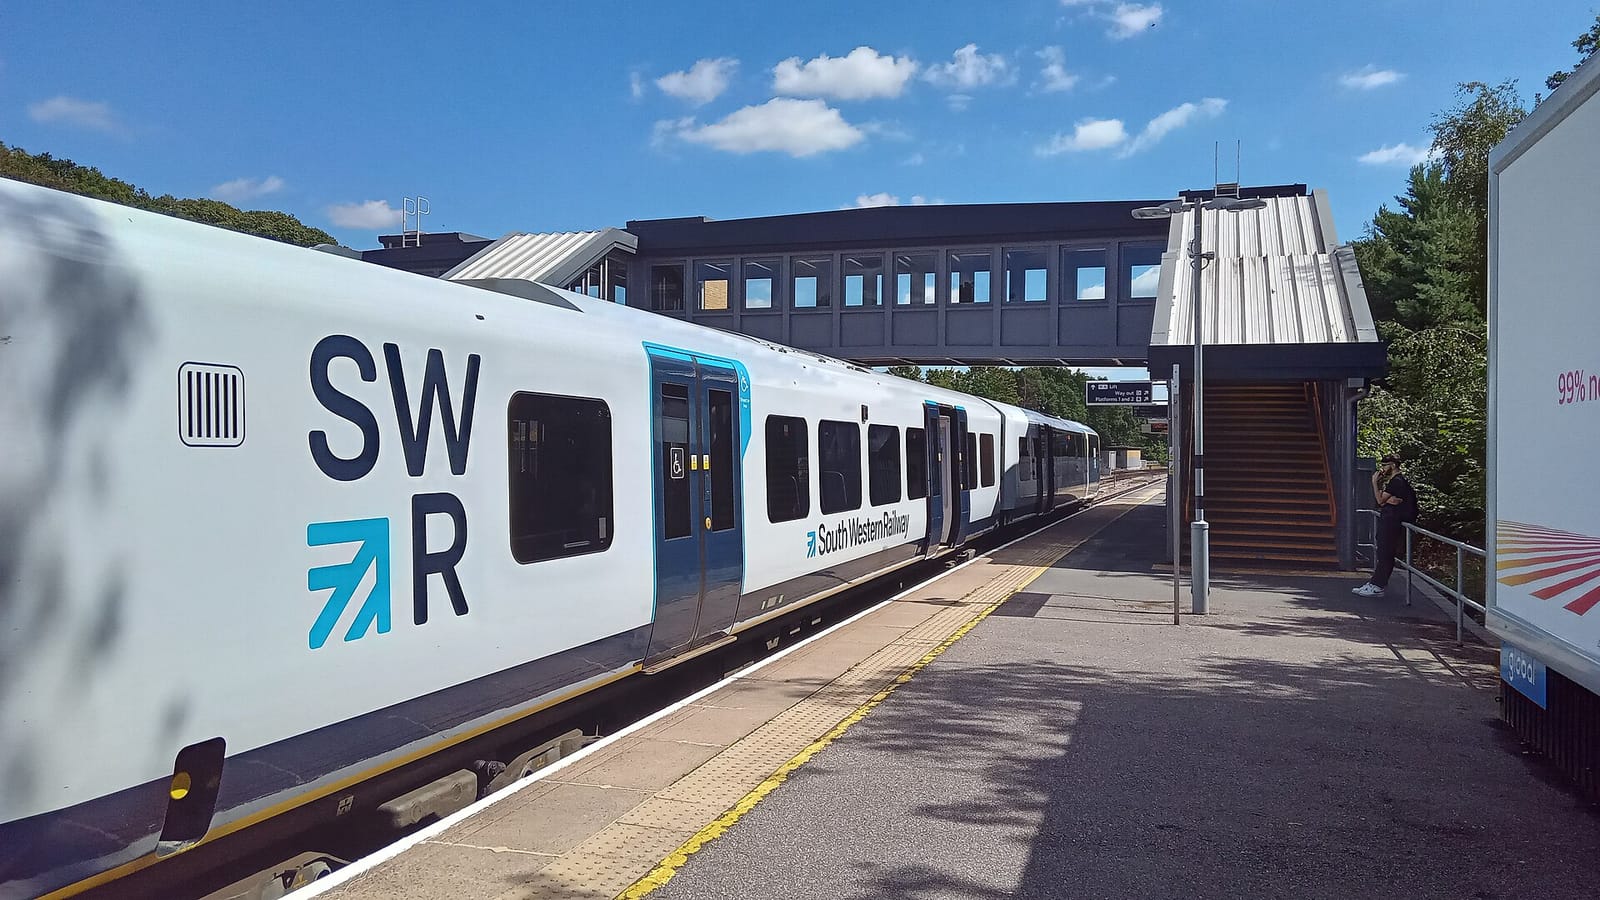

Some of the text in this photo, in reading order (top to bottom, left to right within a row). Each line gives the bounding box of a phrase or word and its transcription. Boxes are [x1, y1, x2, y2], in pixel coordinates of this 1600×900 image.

[308, 334, 481, 481] SW
[1558, 370, 1585, 405] 99%
[411, 492, 469, 625] R
[818, 509, 910, 556] South Western Railway
